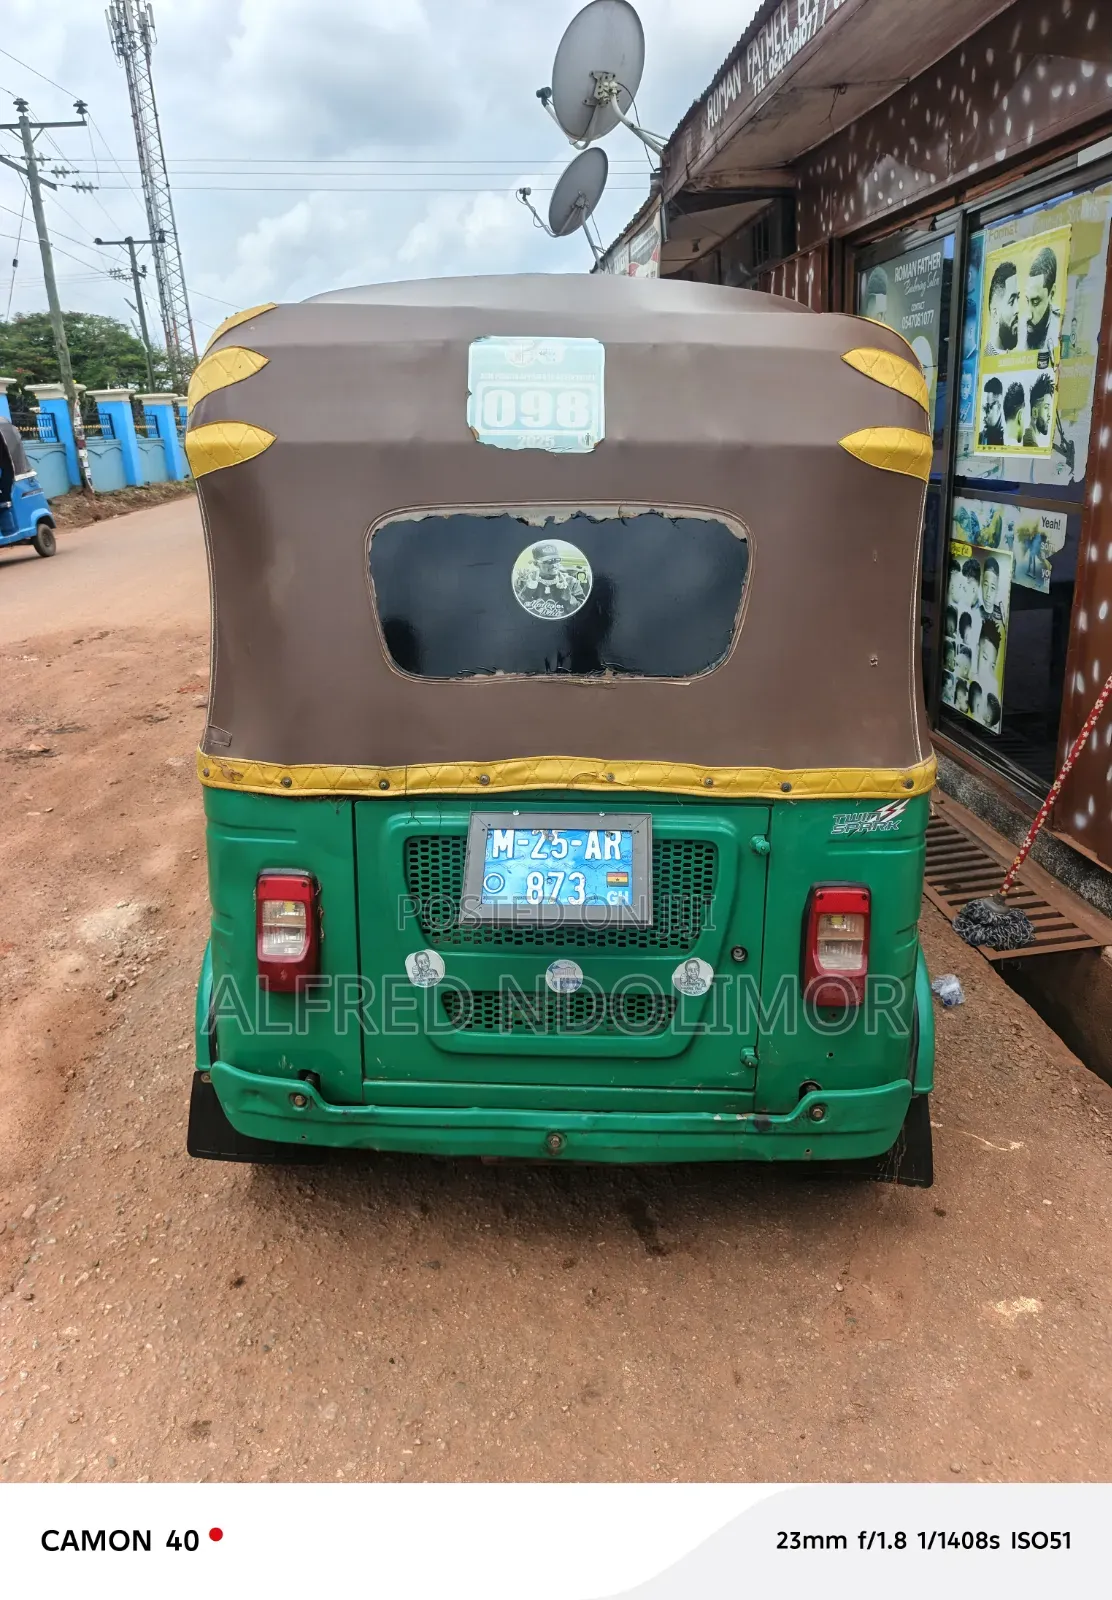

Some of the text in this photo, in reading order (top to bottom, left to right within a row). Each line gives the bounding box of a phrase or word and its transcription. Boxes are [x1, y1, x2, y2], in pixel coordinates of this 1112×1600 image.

[707, 1, 790, 130] ROMAN FATHER
[894, 251, 942, 283] ROMAN FATHER
[483, 389, 590, 428] 098
[1041, 516, 1061, 530] Yeah!
[830, 820, 902, 835] SPARK
[492, 829, 623, 861] M-25-AR
[526, 871, 587, 905] 873
